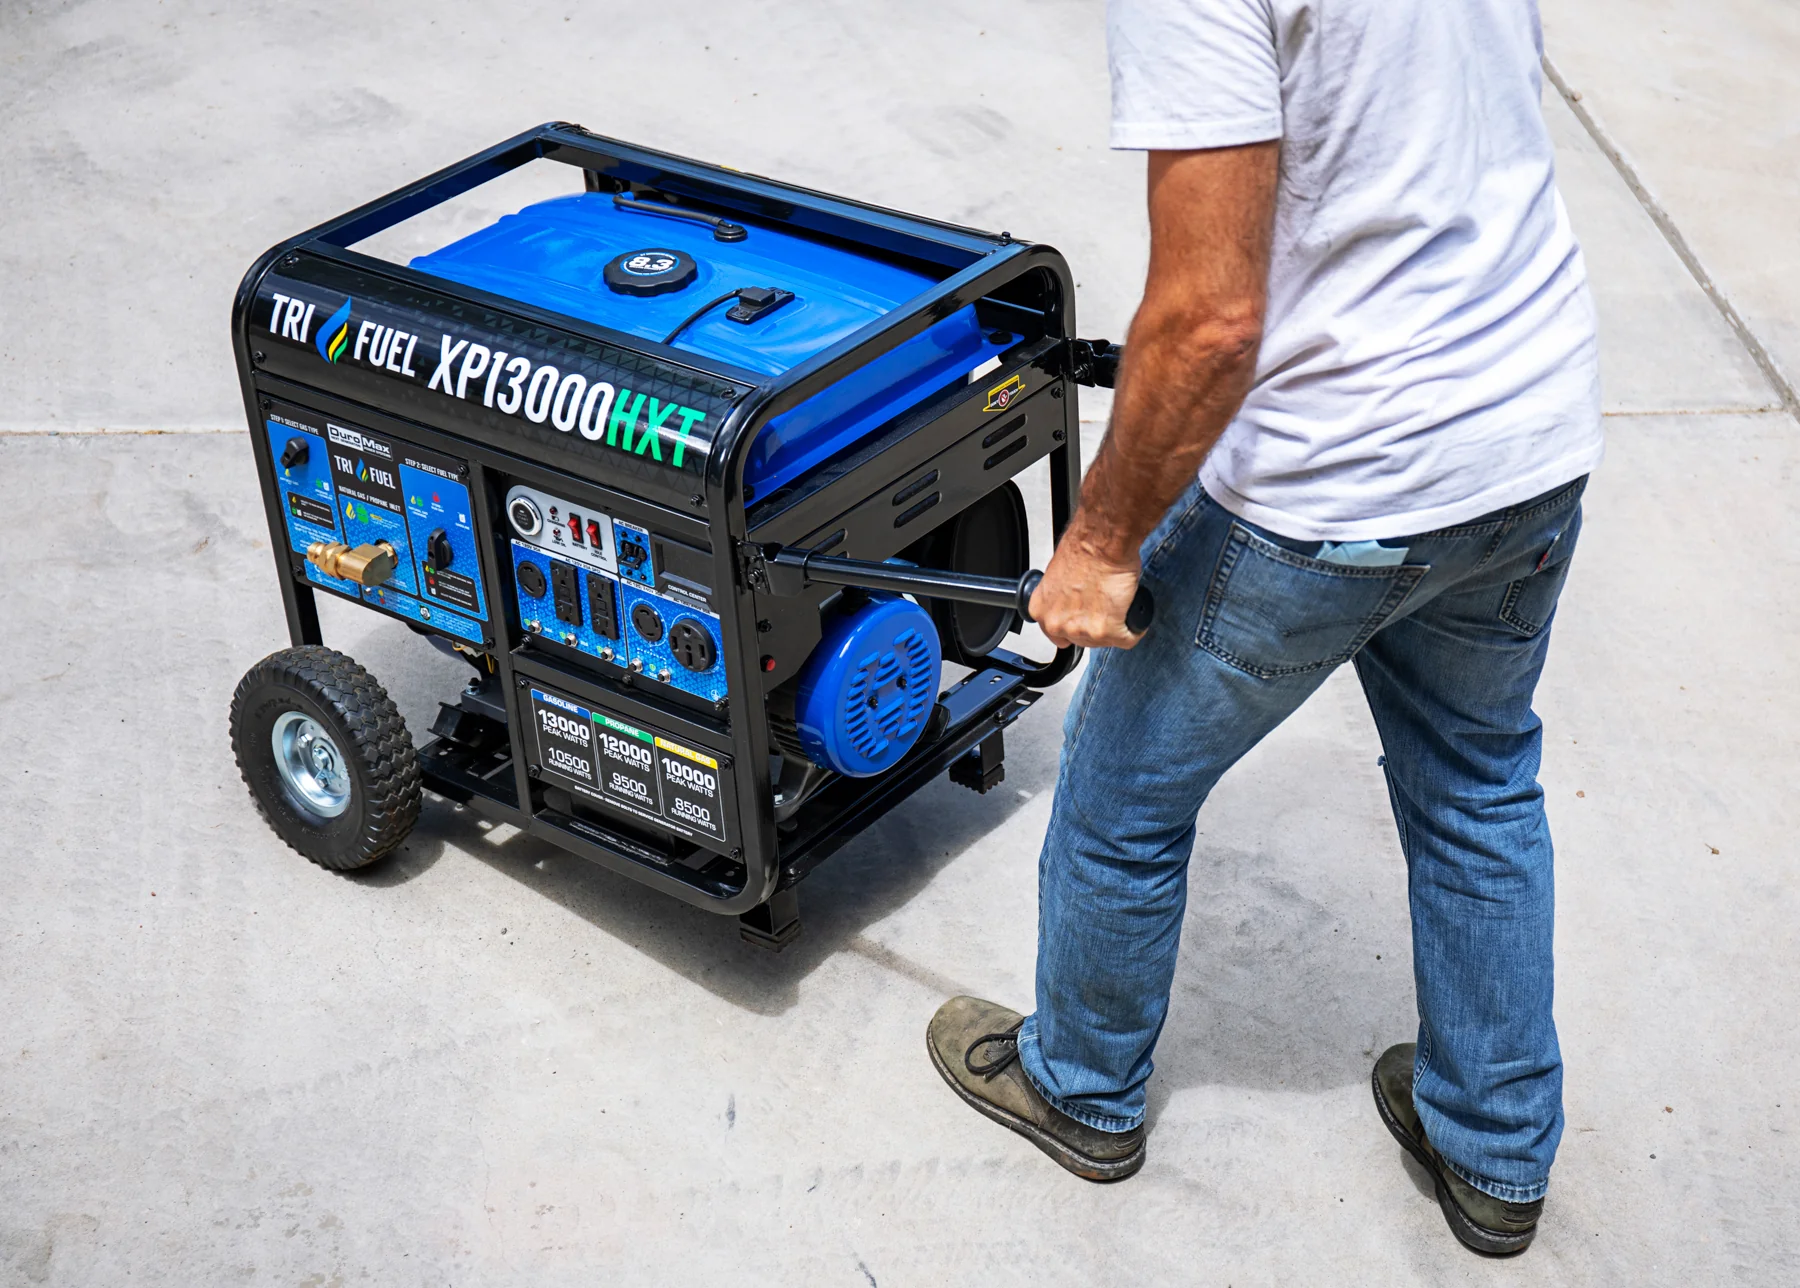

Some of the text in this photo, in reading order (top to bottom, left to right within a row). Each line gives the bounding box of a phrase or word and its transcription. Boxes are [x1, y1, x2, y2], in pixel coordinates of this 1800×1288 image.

[628, 256, 674, 271] 8.3
[269, 293, 706, 468] TRI FUEL XP13000HXT
[270, 414, 281, 422] STEP
[284, 418, 299, 428] SELECT
[299, 423, 308, 432] GAS
[308, 425, 319, 435] TYPE
[333, 455, 397, 489] TRI FUEL
[404, 458, 416, 468] STEP
[421, 462, 437, 474] SELECT
[437, 467, 448, 477] FUEL
[447, 471, 460, 481] TYPE
[338, 485, 357, 498] NATURAL
[357, 491, 366, 500] GAS
[369, 495, 388, 508] PROPANE
[388, 502, 401, 512] INLET
[625, 522, 644, 532] BREAKER
[572, 542, 588, 550] BATTERY
[591, 552, 608, 562] CONTROL
[667, 584, 707, 602] CONTROL CENTER
[543, 694, 579, 713] GASOLINE
[538, 709, 590, 740] 13000
[542, 724, 588, 748] PEAK WATTS
[604, 717, 640, 737] PROPANE
[548, 747, 590, 773] 10500
[599, 733, 652, 765] 12000
[603, 747, 650, 772] PEAK WATTS
[660, 739, 711, 765] NATURAL GAS
[548, 758, 592, 780] RUNNING WATTS
[661, 758, 716, 790] 10000
[609, 782, 653, 805] RUNNING WATTS
[612, 772, 647, 796] 9500
[666, 773, 714, 798] PEAK WATTS
[574, 785, 591, 795] BATTERY
[620, 804, 633, 812] BOLTS
[637, 811, 654, 821] SERVICE
[653, 818, 676, 830] GENERATOR
[676, 827, 693, 837] BATTERY
[671, 807, 717, 831] RUNNING WATTS
[675, 797, 711, 822] 8500
